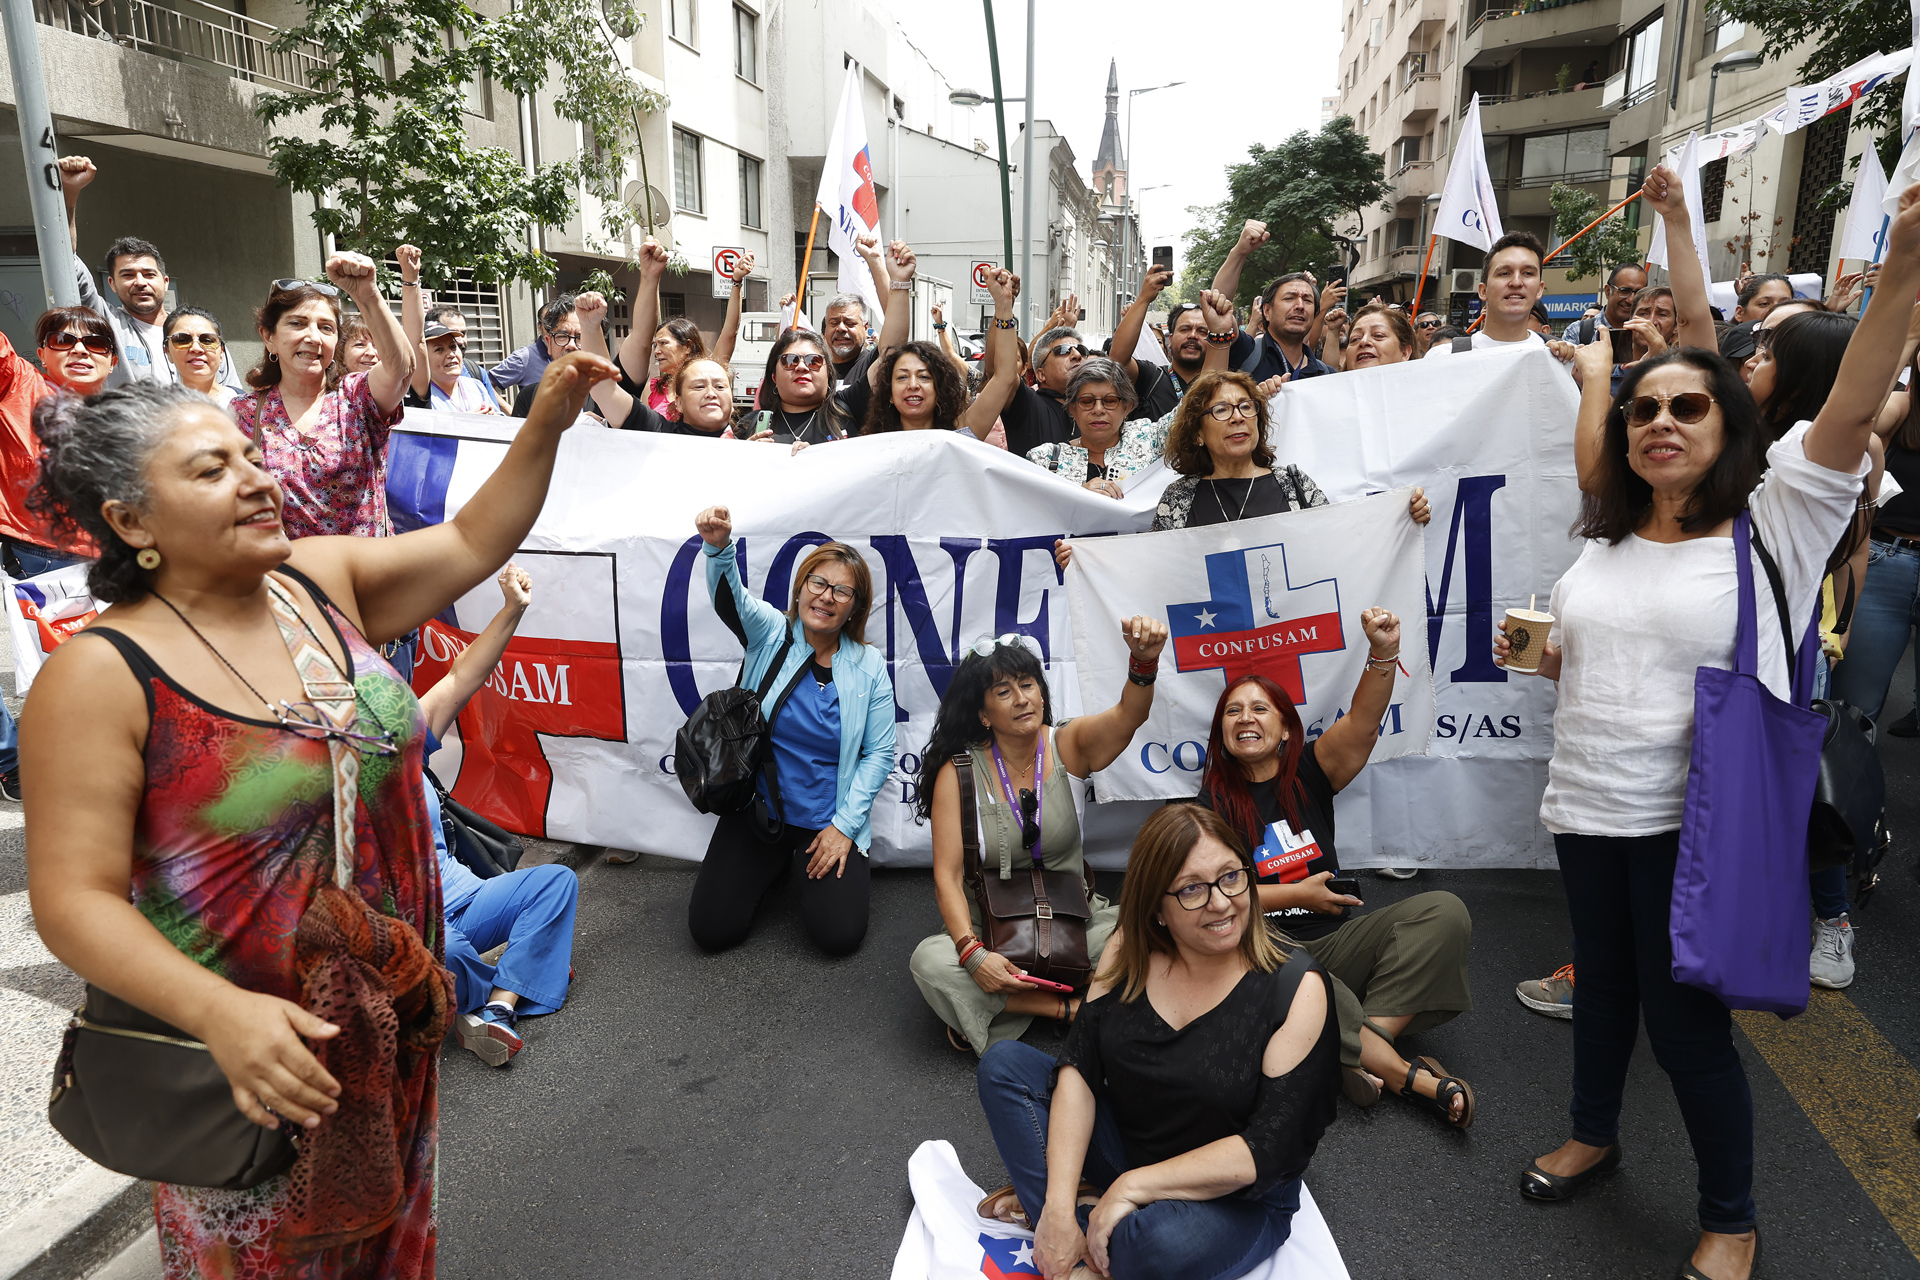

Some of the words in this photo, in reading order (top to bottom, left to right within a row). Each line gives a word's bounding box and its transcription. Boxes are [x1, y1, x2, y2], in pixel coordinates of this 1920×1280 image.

[1543, 302, 1596, 312] NIMARK
[28, 605, 84, 635] COSAM
[1199, 626, 1318, 657] CONFUSAM
[1437, 713, 1521, 744] S/AS
[1267, 848, 1314, 869] CONFUSAM
